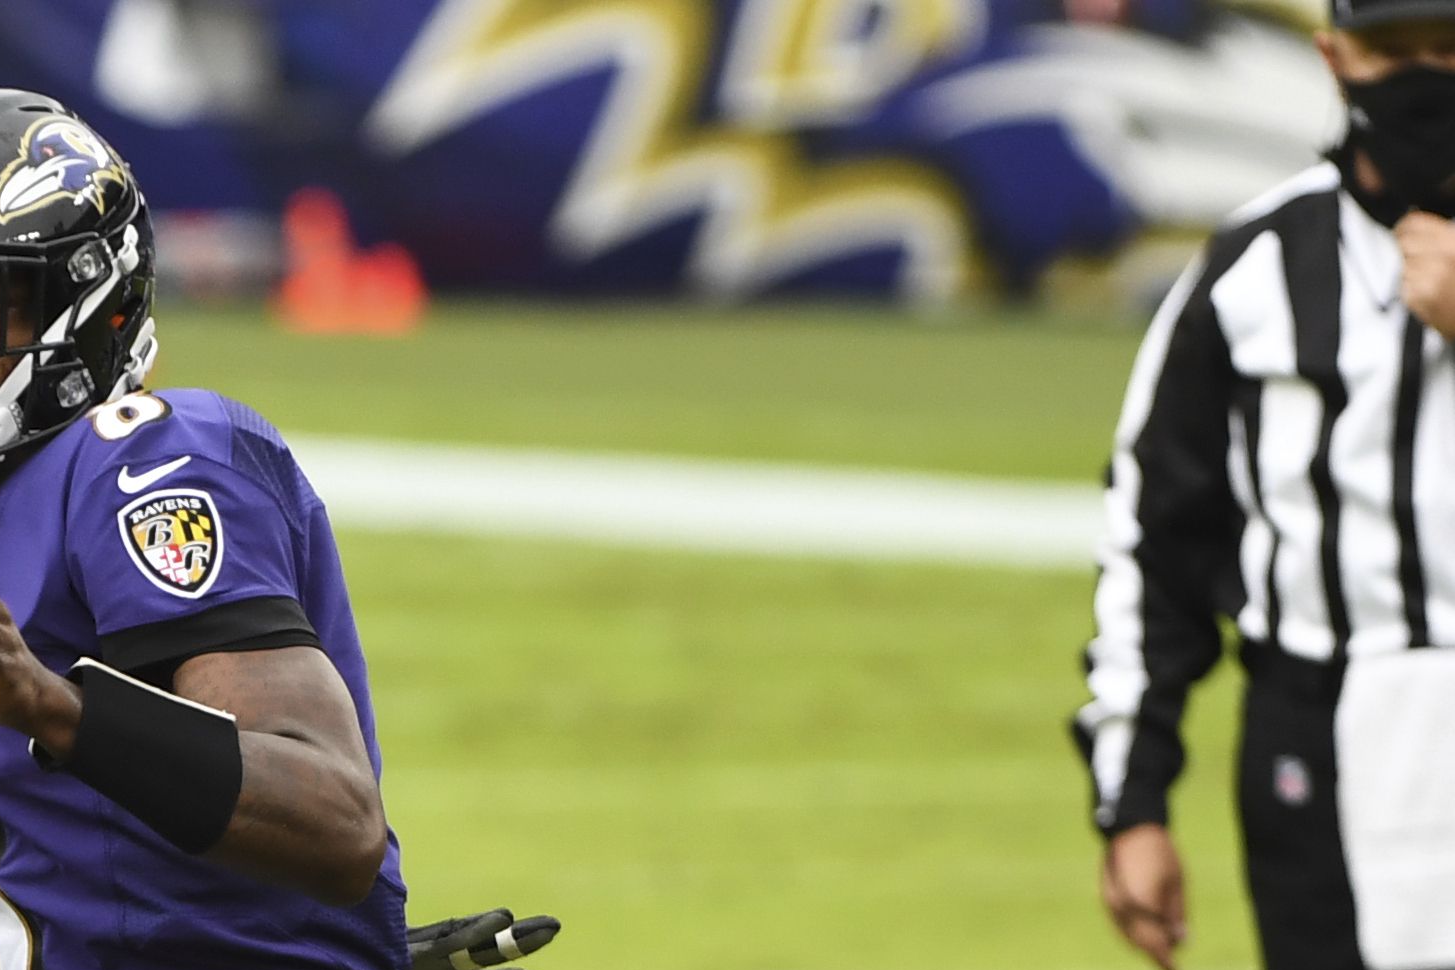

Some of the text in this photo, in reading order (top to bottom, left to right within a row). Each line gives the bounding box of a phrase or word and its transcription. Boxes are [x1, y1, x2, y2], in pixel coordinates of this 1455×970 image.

[129, 498, 202, 524] RAVENS
[144, 514, 174, 550] B
[183, 541, 211, 573] R
